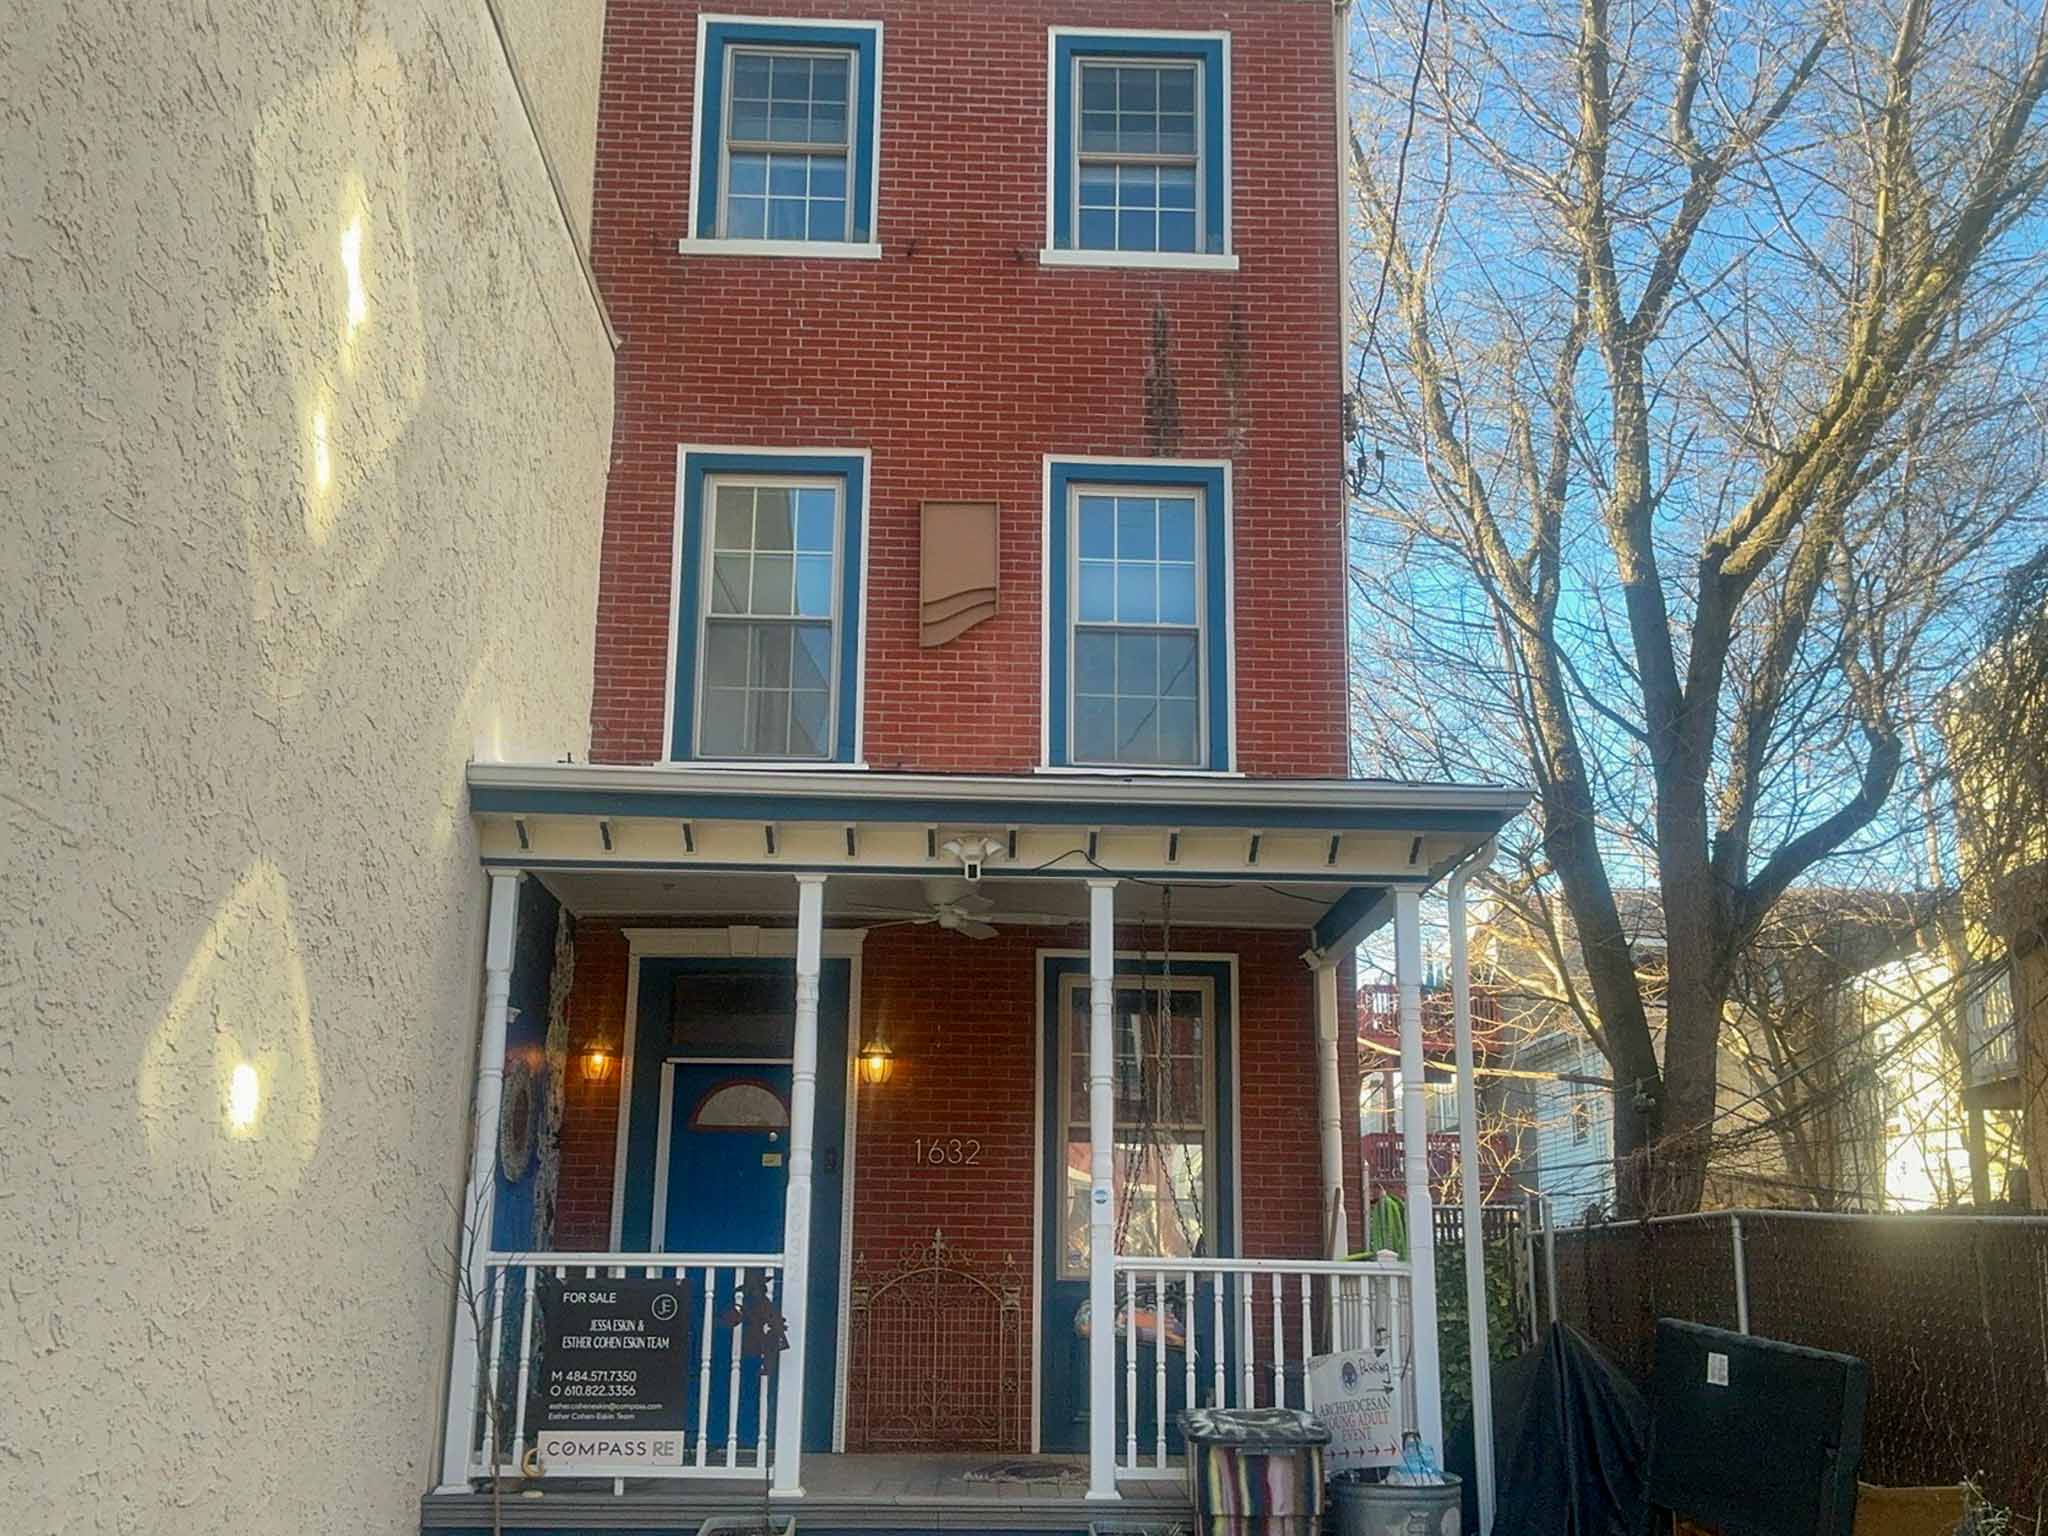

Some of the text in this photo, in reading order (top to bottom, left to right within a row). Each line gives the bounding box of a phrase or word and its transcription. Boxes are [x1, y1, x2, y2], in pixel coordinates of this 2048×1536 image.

[914, 1138, 981, 1165] 1632
[562, 1292, 617, 1304] FOR SALE
[589, 1319, 645, 1332] JESSA ESKIN &
[562, 1336, 670, 1349] ESTHER COHEN ESKIN TEAM
[551, 1371, 637, 1382] M 484.571.7350
[550, 1385, 637, 1397] O 610.822.3356
[1358, 1411, 1389, 1426] ADULT
[546, 1441, 675, 1457] COMPASS RE
